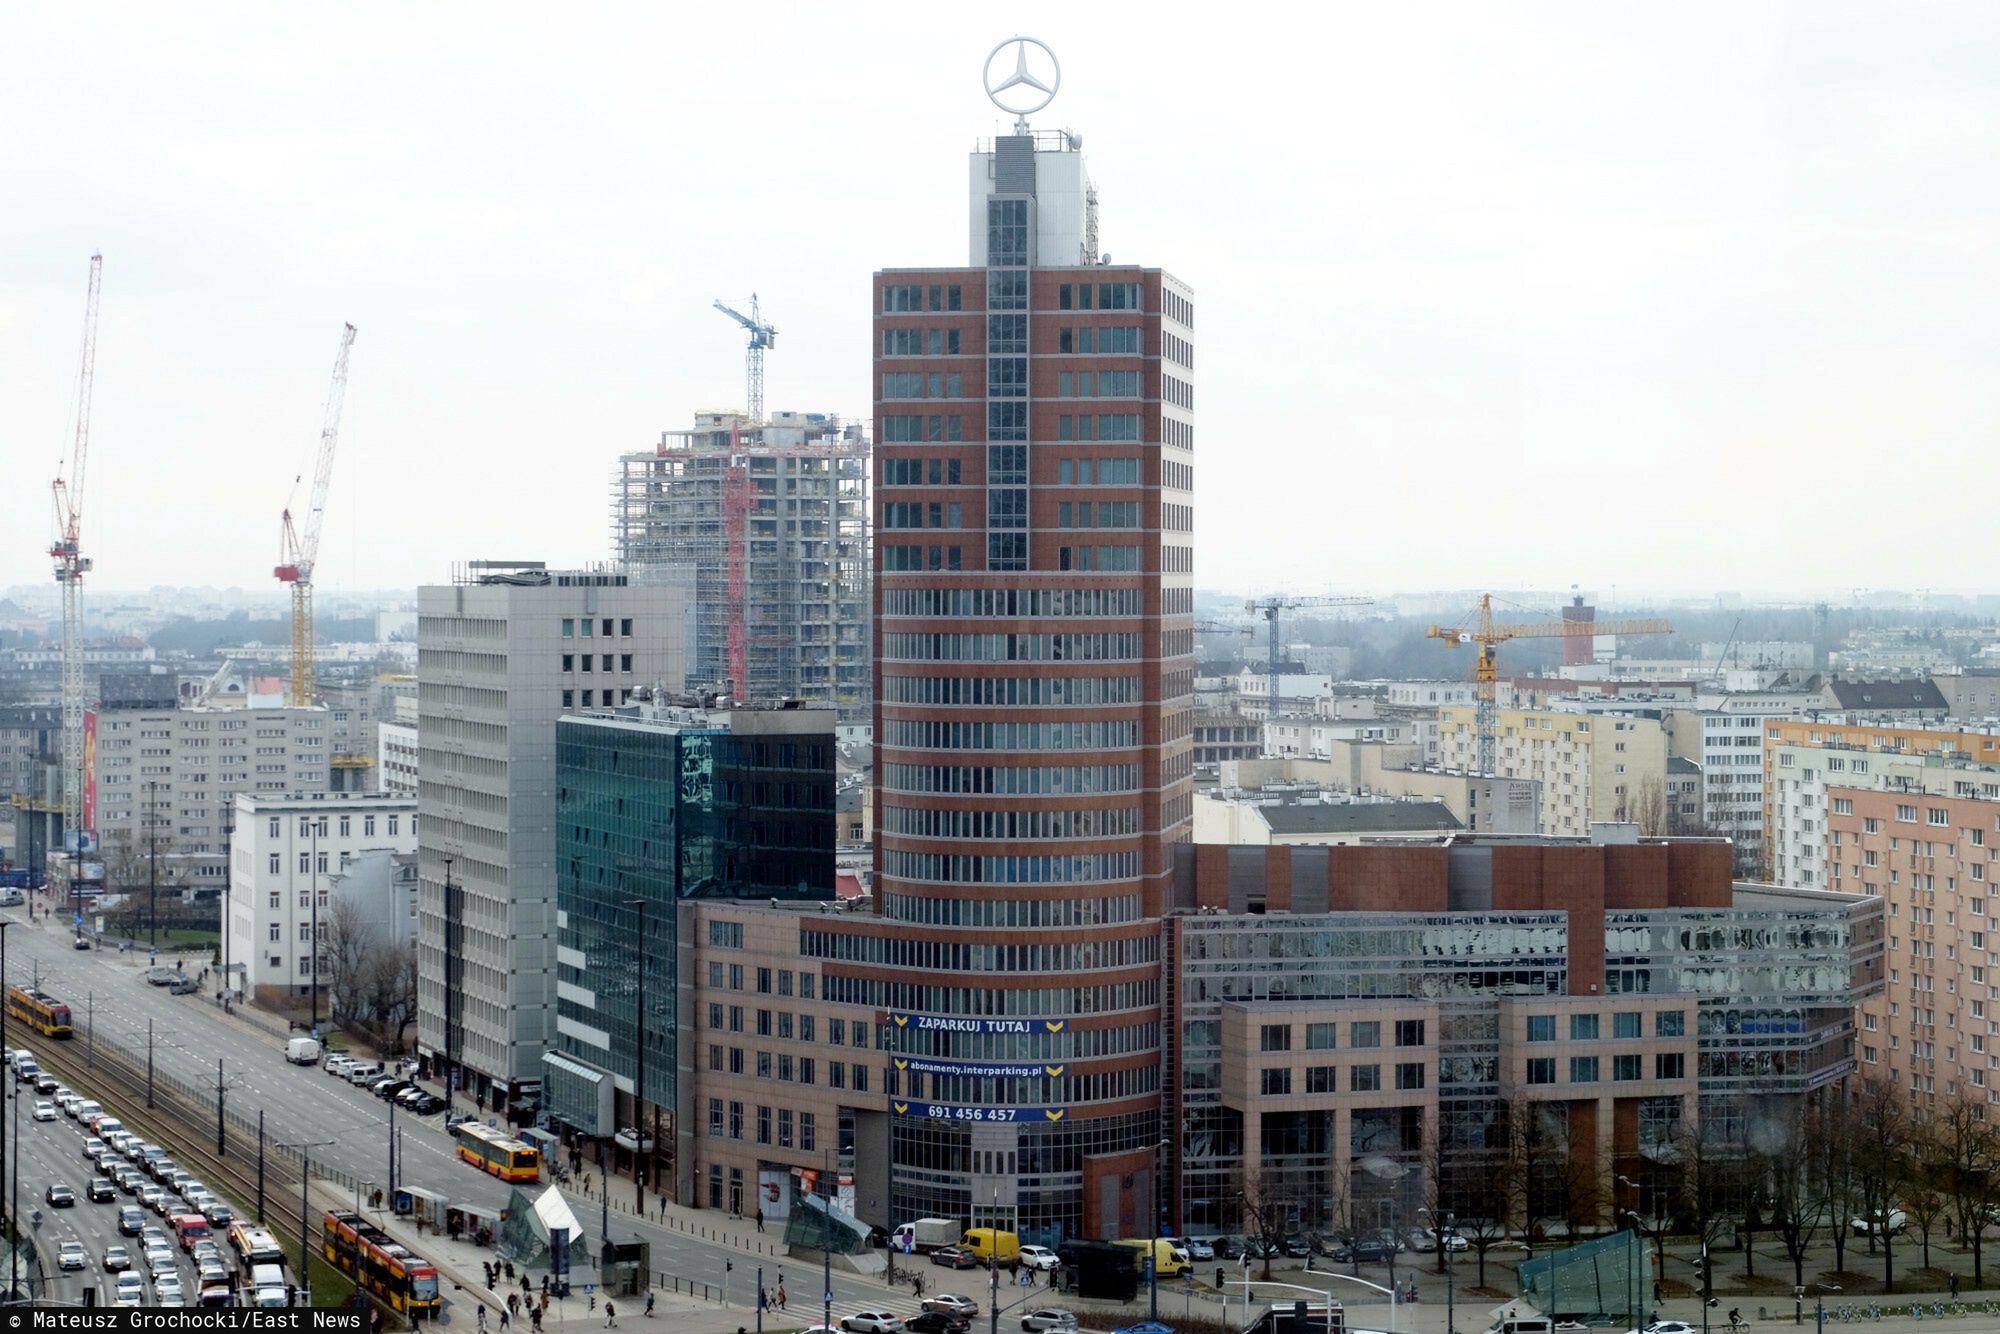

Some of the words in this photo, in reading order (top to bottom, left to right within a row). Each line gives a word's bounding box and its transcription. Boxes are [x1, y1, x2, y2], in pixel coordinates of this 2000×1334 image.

[918, 1016, 981, 1033] ZAPARKUJ
[986, 1020, 1030, 1033] TUTAJ
[910, 1061, 1042, 1077] abonamenty.interparking.pl
[928, 1105, 951, 1119] 691
[955, 1108, 983, 1121] 456
[987, 1109, 1017, 1121] 457
